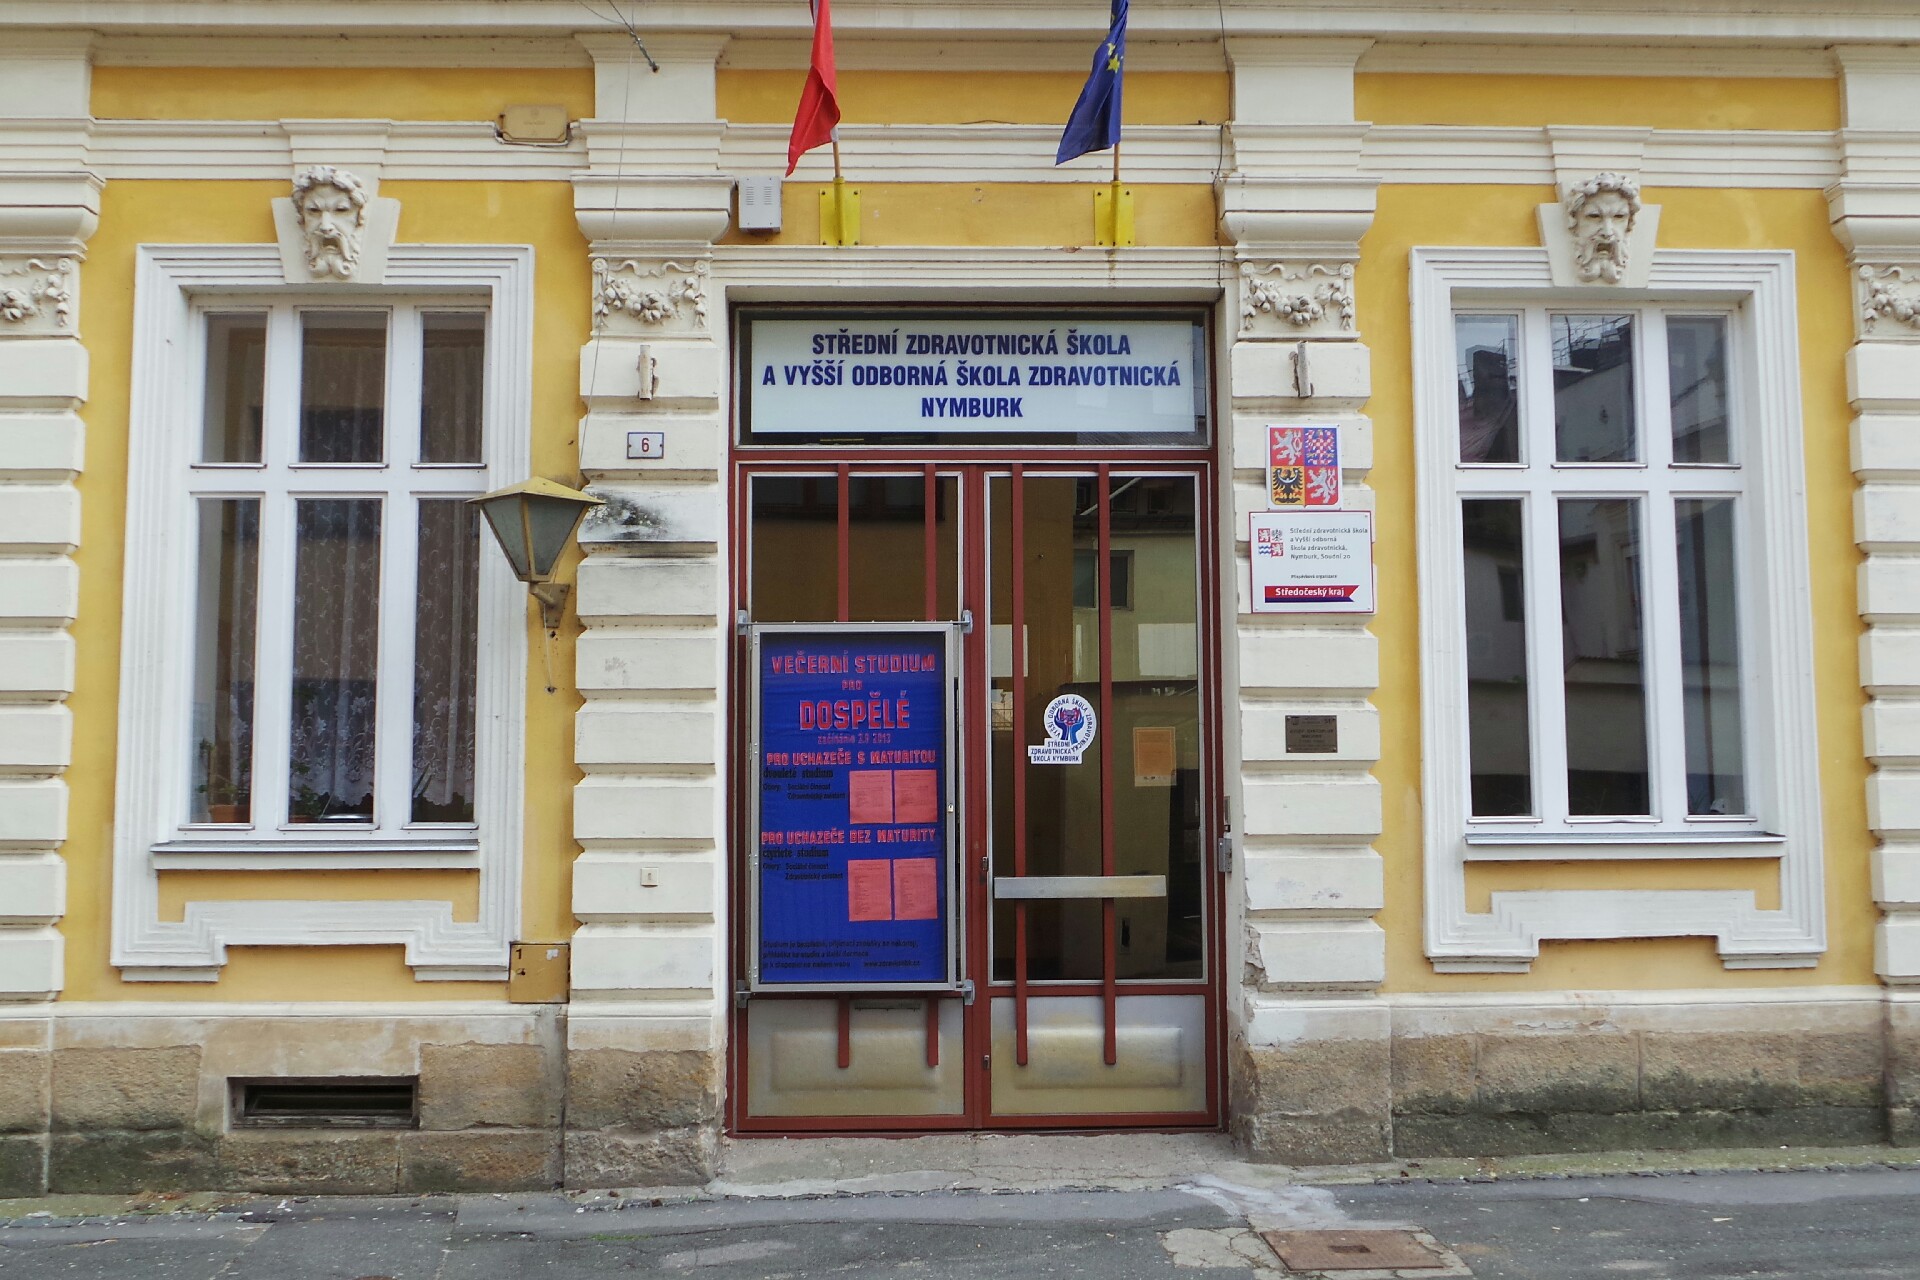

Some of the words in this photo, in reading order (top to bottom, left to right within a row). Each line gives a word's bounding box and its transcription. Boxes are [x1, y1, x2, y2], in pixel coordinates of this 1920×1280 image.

[812, 328, 899, 355] STŘEDNÍ
[905, 329, 1058, 355] ZDRAVOTNICKÁ
[1066, 329, 1131, 355] ŠKOLA
[762, 365, 776, 386] A
[784, 360, 845, 386] VYŠŠÍ
[852, 360, 948, 386] ODBORNÁ
[956, 360, 1021, 386] ŠKOLA
[1028, 360, 1181, 386] ZDRAVOTNICKÁ
[921, 397, 1024, 418] NYMBURK
[641, 437, 650, 453] 6
[1276, 588, 1327, 597] Středočeský
[1328, 588, 1344, 597] kraj
[772, 650, 849, 674] VEČERNÍ
[855, 653, 936, 673] STUDIUM
[841, 680, 863, 690] PRO
[800, 690, 910, 730] DOSPĚLÉ
[766, 752, 789, 765] PRO
[793, 748, 852, 765] UCHAZEČE
[858, 752, 866, 764] S
[870, 750, 936, 764] MATURITOU
[762, 831, 783, 844] PRO
[787, 827, 844, 844] UCHAZEČE
[850, 830, 870, 844] BEZ
[878, 828, 936, 843] MATURITY
[516, 948, 522, 960] 1
